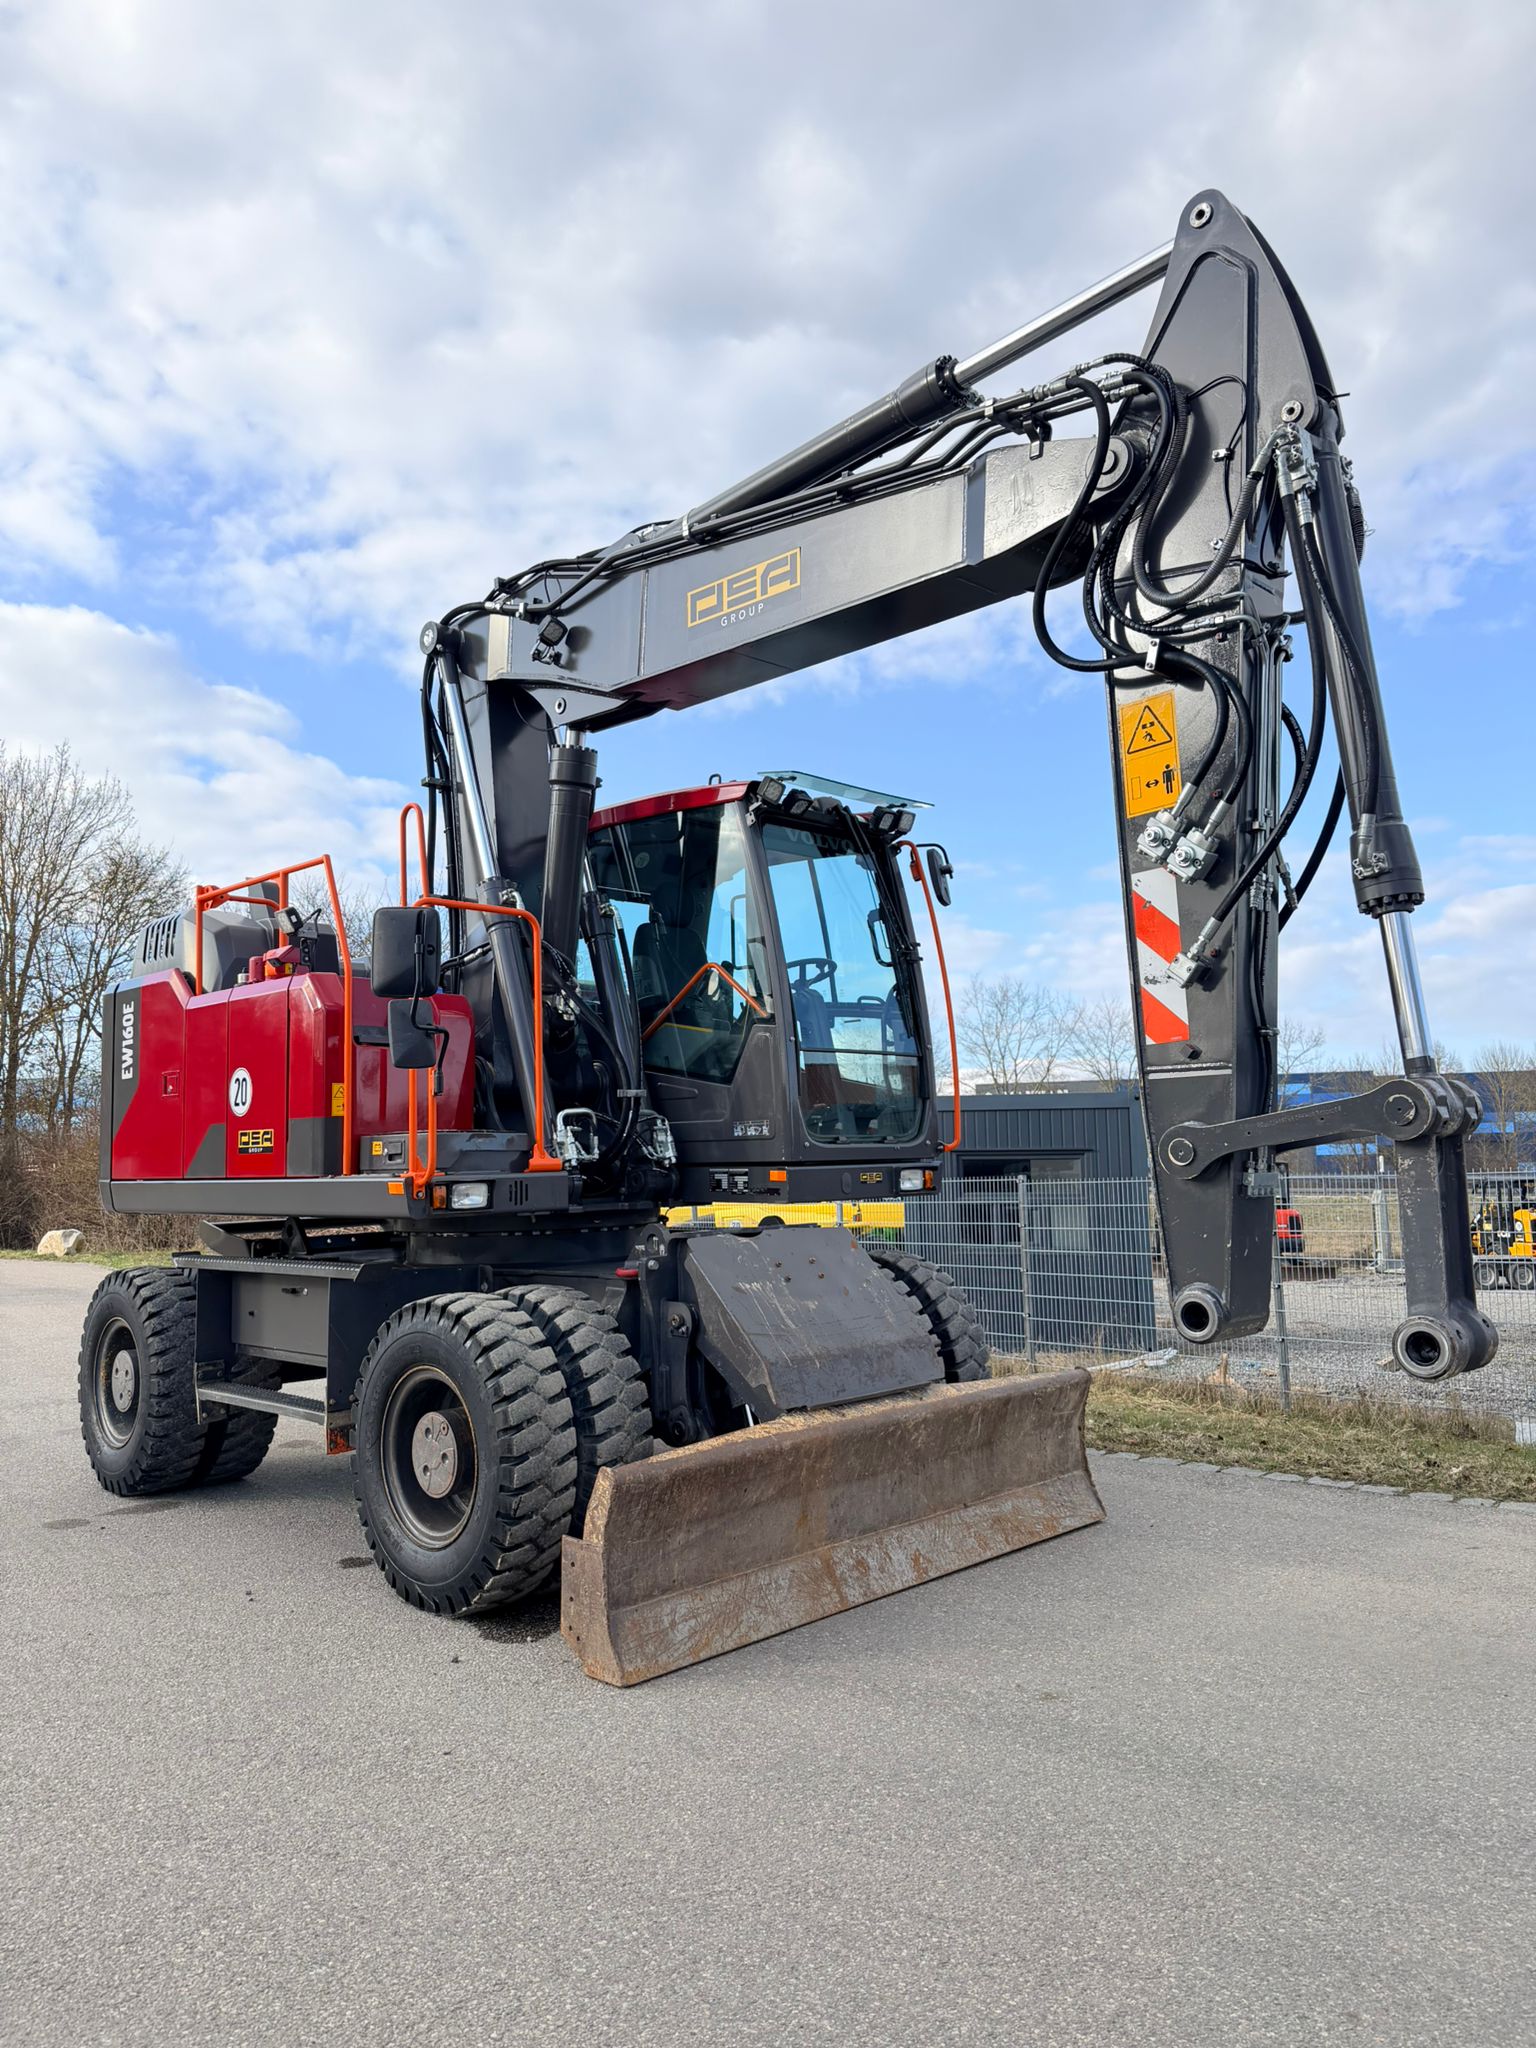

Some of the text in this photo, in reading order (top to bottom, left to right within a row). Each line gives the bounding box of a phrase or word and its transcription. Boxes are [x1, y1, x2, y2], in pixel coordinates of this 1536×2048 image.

[720, 602, 765, 627] GROUP
[783, 828, 856, 852] VOLVO
[121, 1000, 135, 1080] EW160E
[234, 1077, 248, 1107] 20
